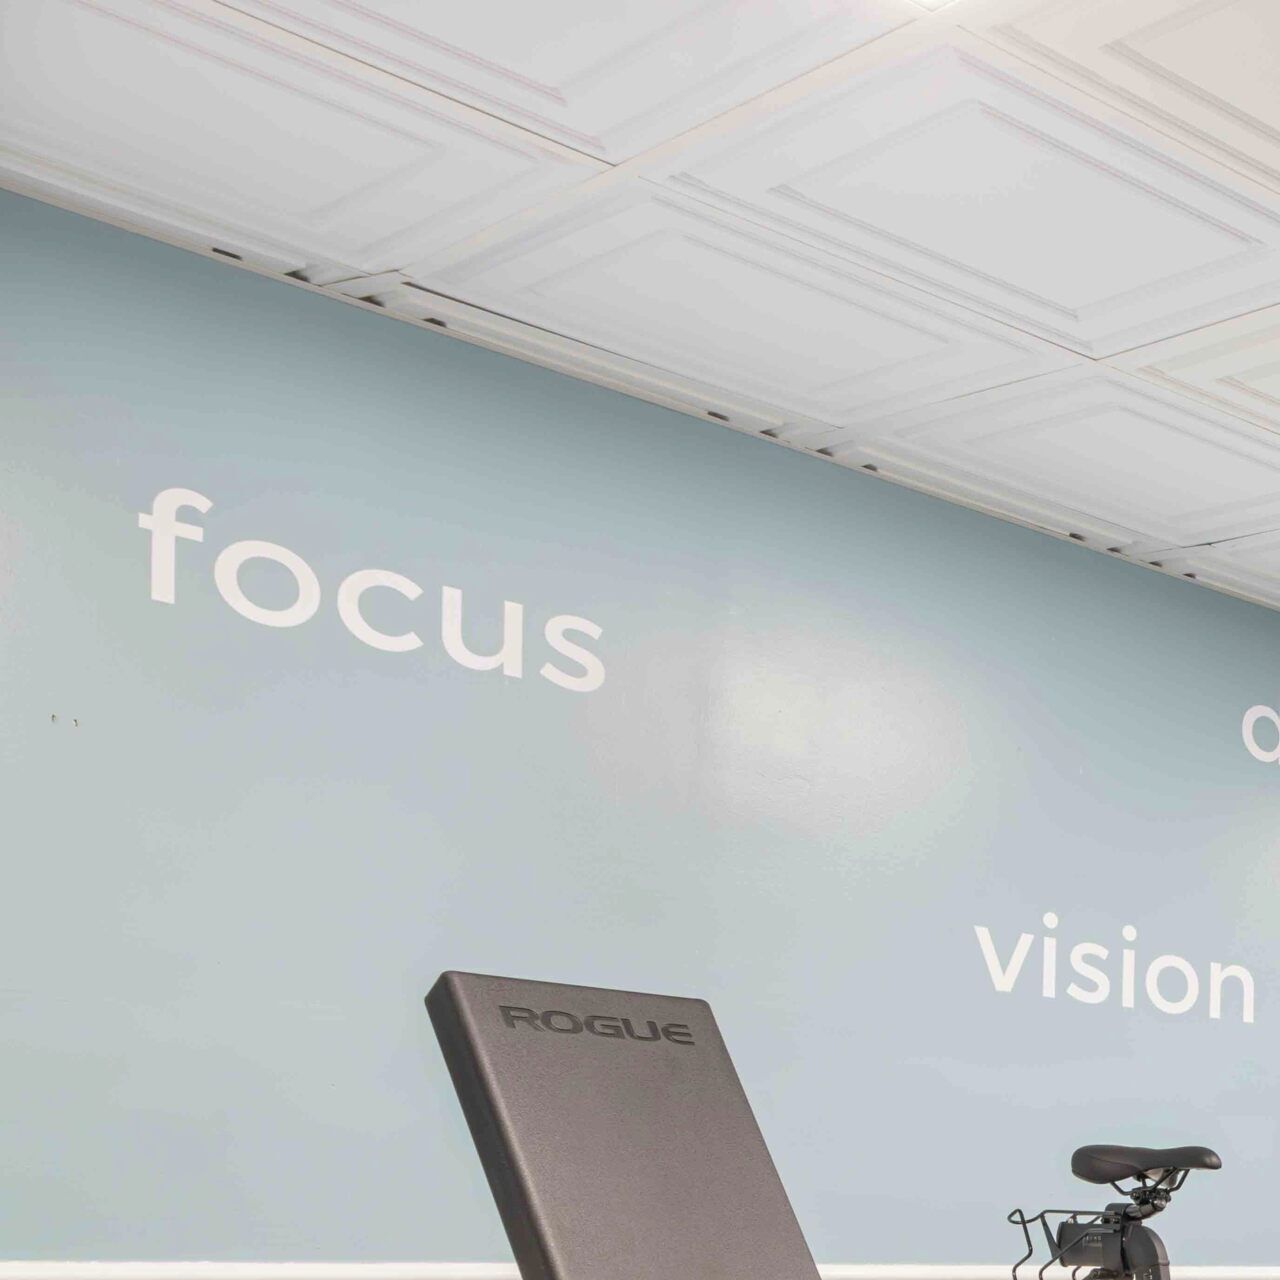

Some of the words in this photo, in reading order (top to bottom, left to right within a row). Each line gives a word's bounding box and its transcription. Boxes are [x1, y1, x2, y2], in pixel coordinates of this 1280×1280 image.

[138, 487, 606, 693] focus
[974, 912, 1255, 1024] vision
[499, 1005, 696, 1046] ROGUE
